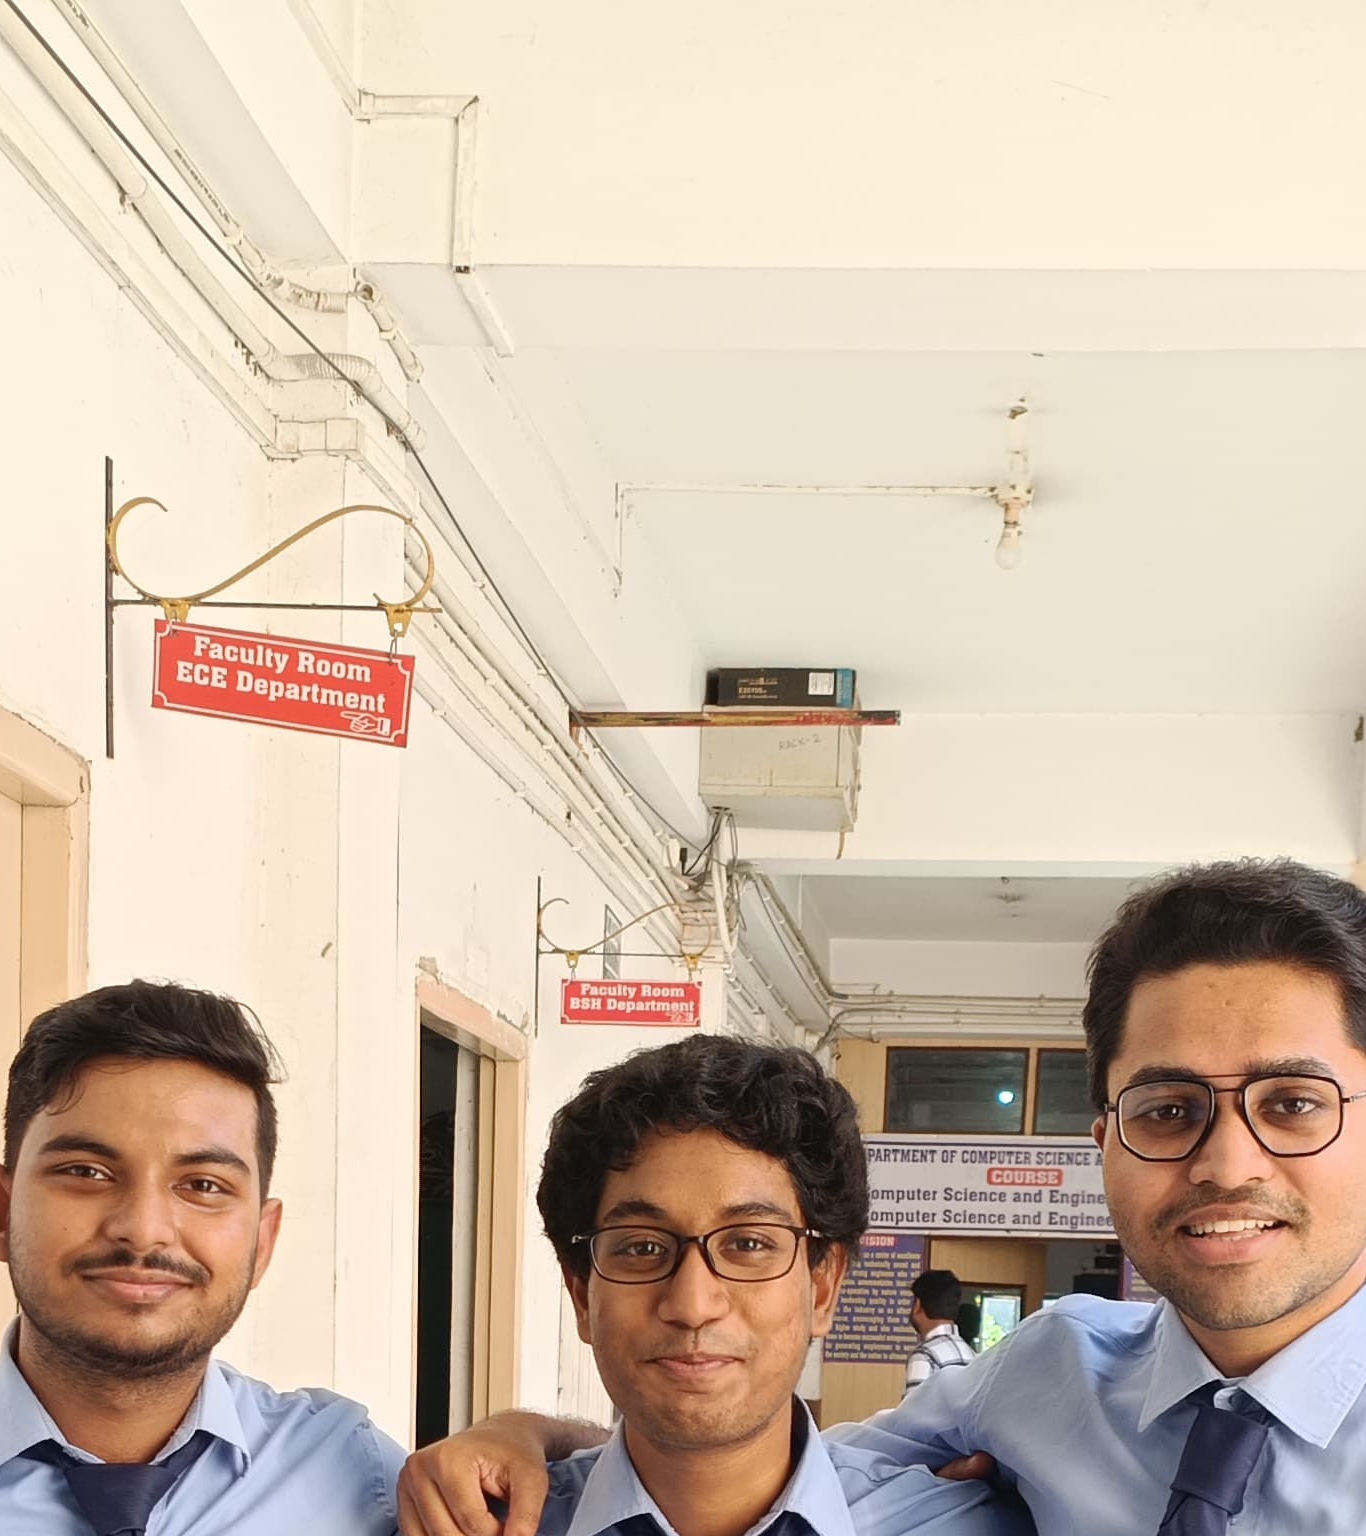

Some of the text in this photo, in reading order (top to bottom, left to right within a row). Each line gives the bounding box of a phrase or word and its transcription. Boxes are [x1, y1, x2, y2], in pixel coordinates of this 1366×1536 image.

[194, 635, 371, 683] Faculty Room
[176, 661, 386, 713] ECE Department
[580, 983, 684, 999] Faculty Room
[570, 997, 694, 1013] BSH Department
[867, 1148, 937, 1163] PARTMENT
[941, 1149, 957, 1164] OF
[961, 1149, 1031, 1165] COMPUTER
[1036, 1151, 1092, 1166] SCIENCE
[991, 1170, 1059, 1184] COURSE
[869, 1187, 1105, 1207] omputer Science and Engine
[869, 1209, 1114, 1229] omputer Science and Enginee
